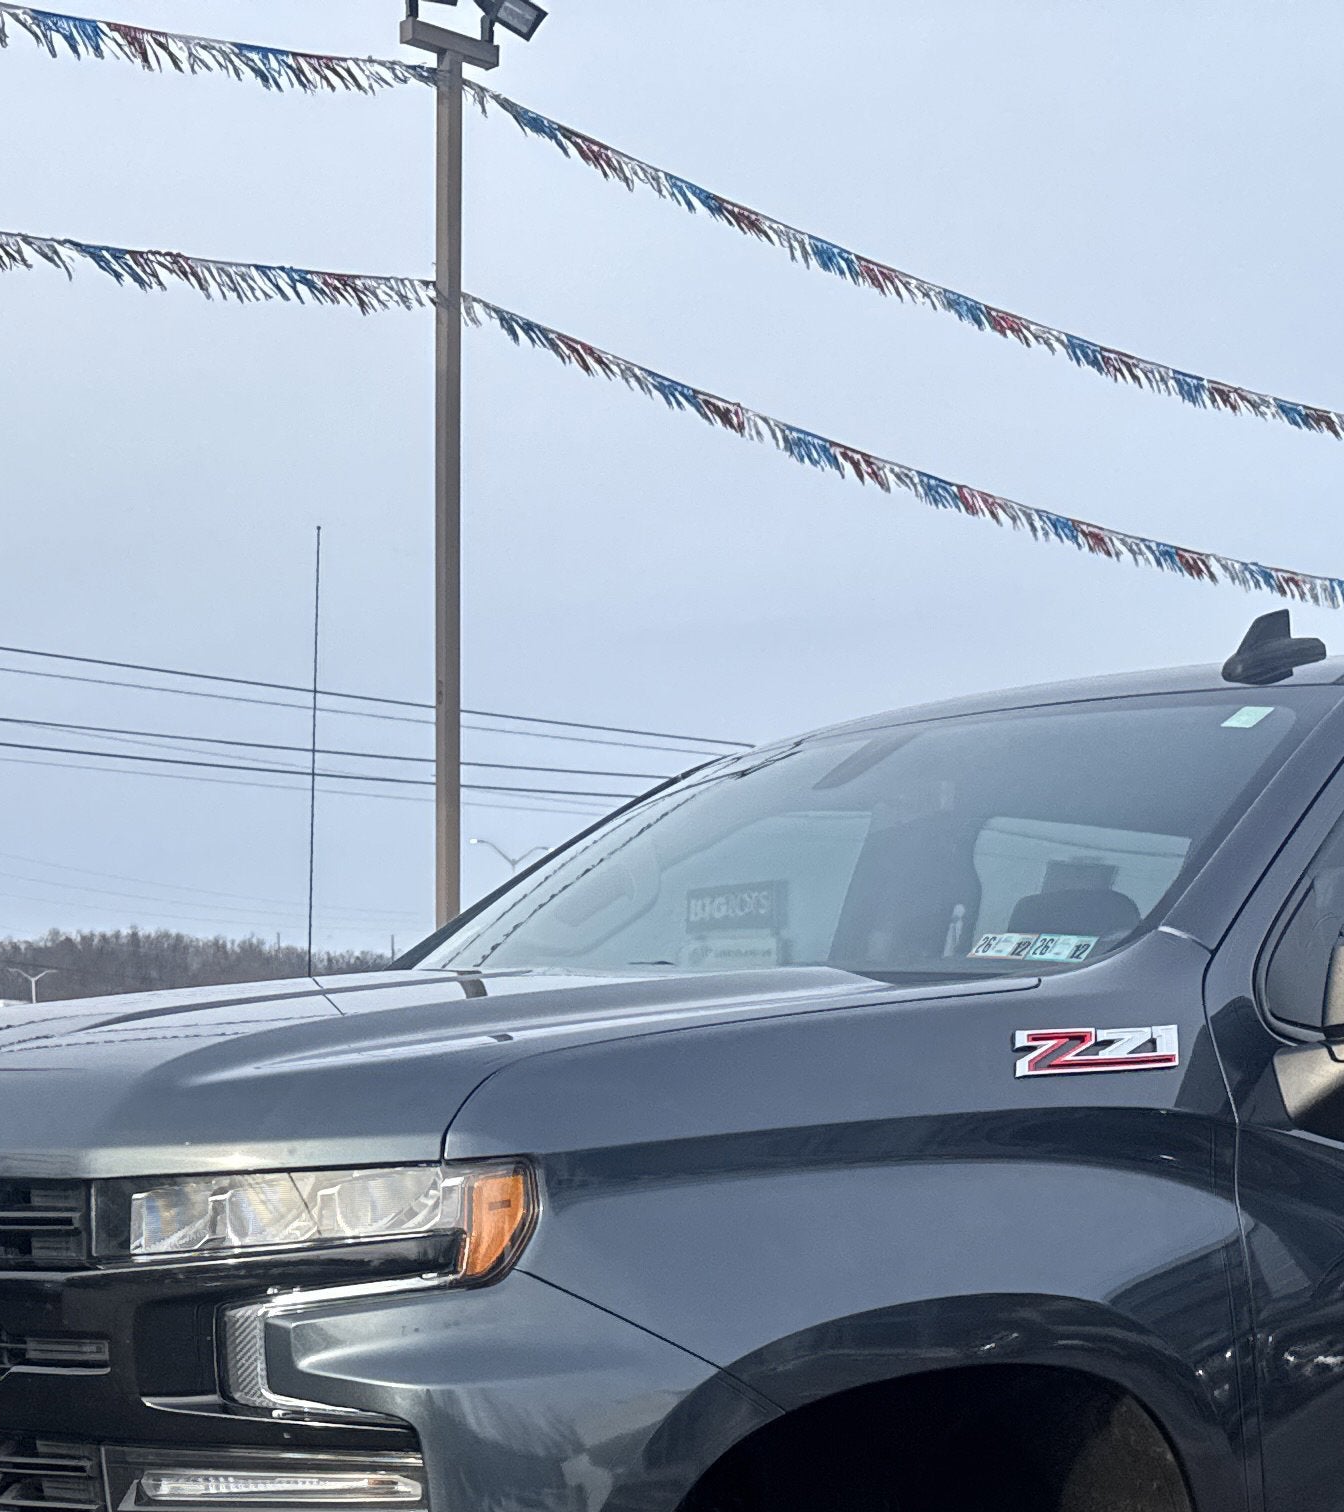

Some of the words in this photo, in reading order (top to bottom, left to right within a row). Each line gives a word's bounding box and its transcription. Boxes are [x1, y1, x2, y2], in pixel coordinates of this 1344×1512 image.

[975, 936, 997, 954] 26
[1010, 940, 1032, 957] 12
[1032, 937, 1054, 956] 26
[1014, 1024, 1179, 1078] Z71
